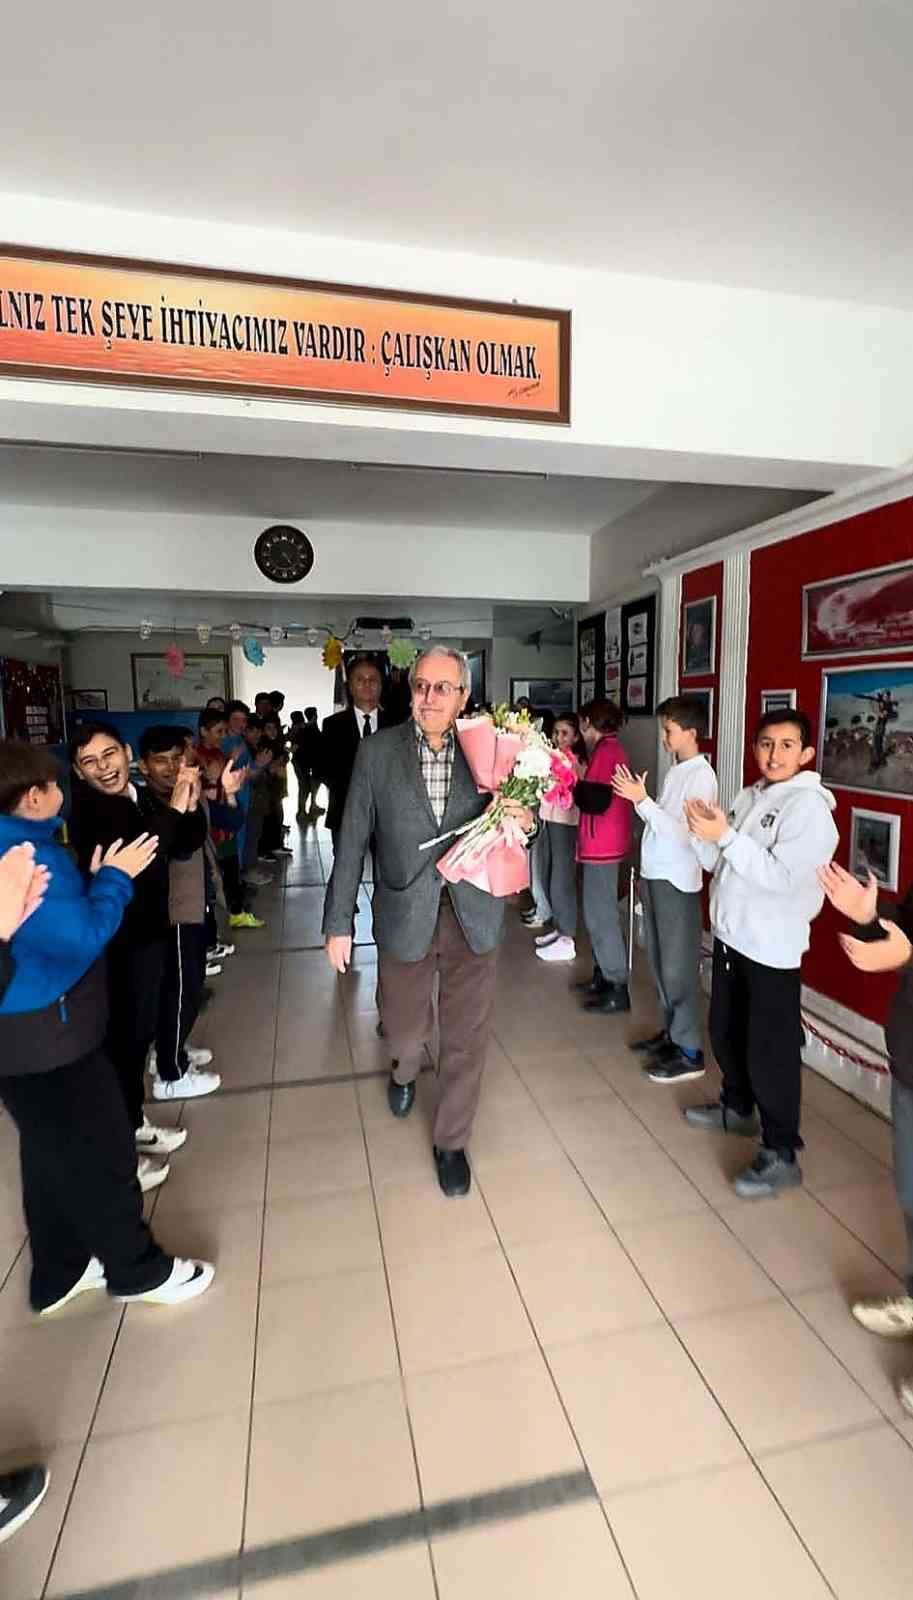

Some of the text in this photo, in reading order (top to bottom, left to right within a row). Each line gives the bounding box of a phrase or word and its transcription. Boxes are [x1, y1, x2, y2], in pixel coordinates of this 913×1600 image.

[51, 295, 95, 336] TEK
[101, 300, 154, 350] ŞEYE
[160, 295, 289, 355] İHTİYACIMIZ
[293, 320, 366, 362] VARDIR
[380, 330, 471, 380] ÇALIŞKAN
